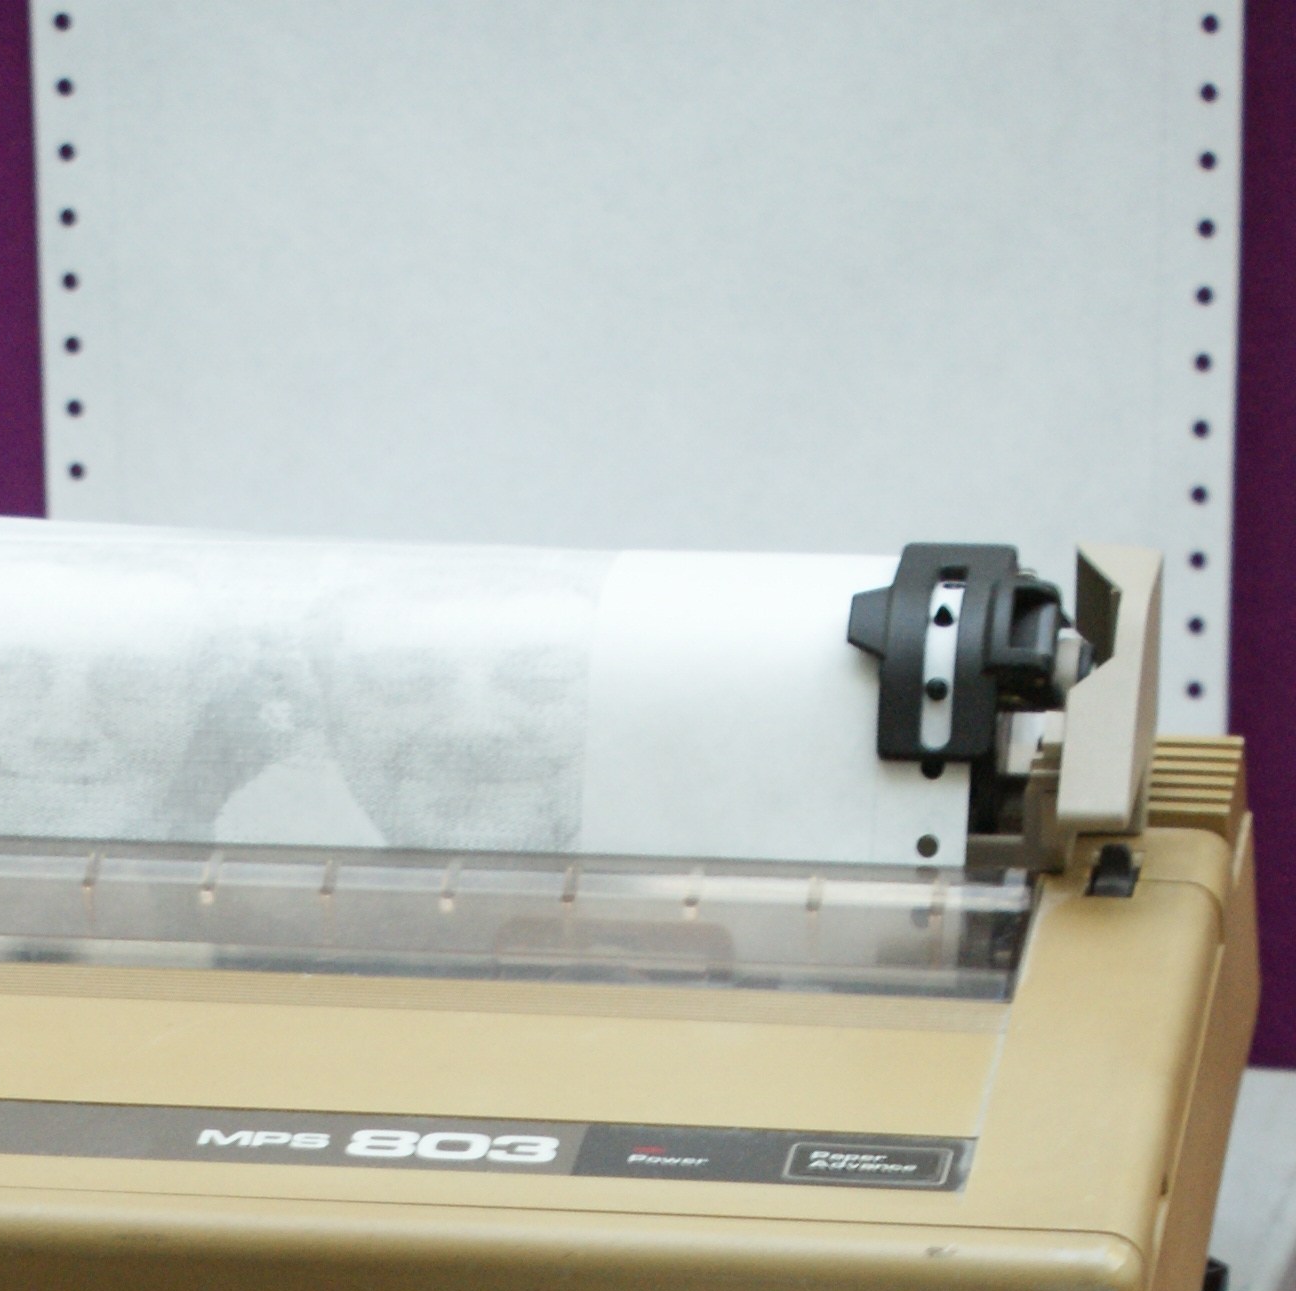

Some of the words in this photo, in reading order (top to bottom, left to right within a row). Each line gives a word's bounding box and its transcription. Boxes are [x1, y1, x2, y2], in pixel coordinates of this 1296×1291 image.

[197, 1128, 331, 1150] MPS
[346, 1128, 560, 1163] 803
[626, 1153, 710, 1168] Power
[808, 1159, 918, 1174] Advance
